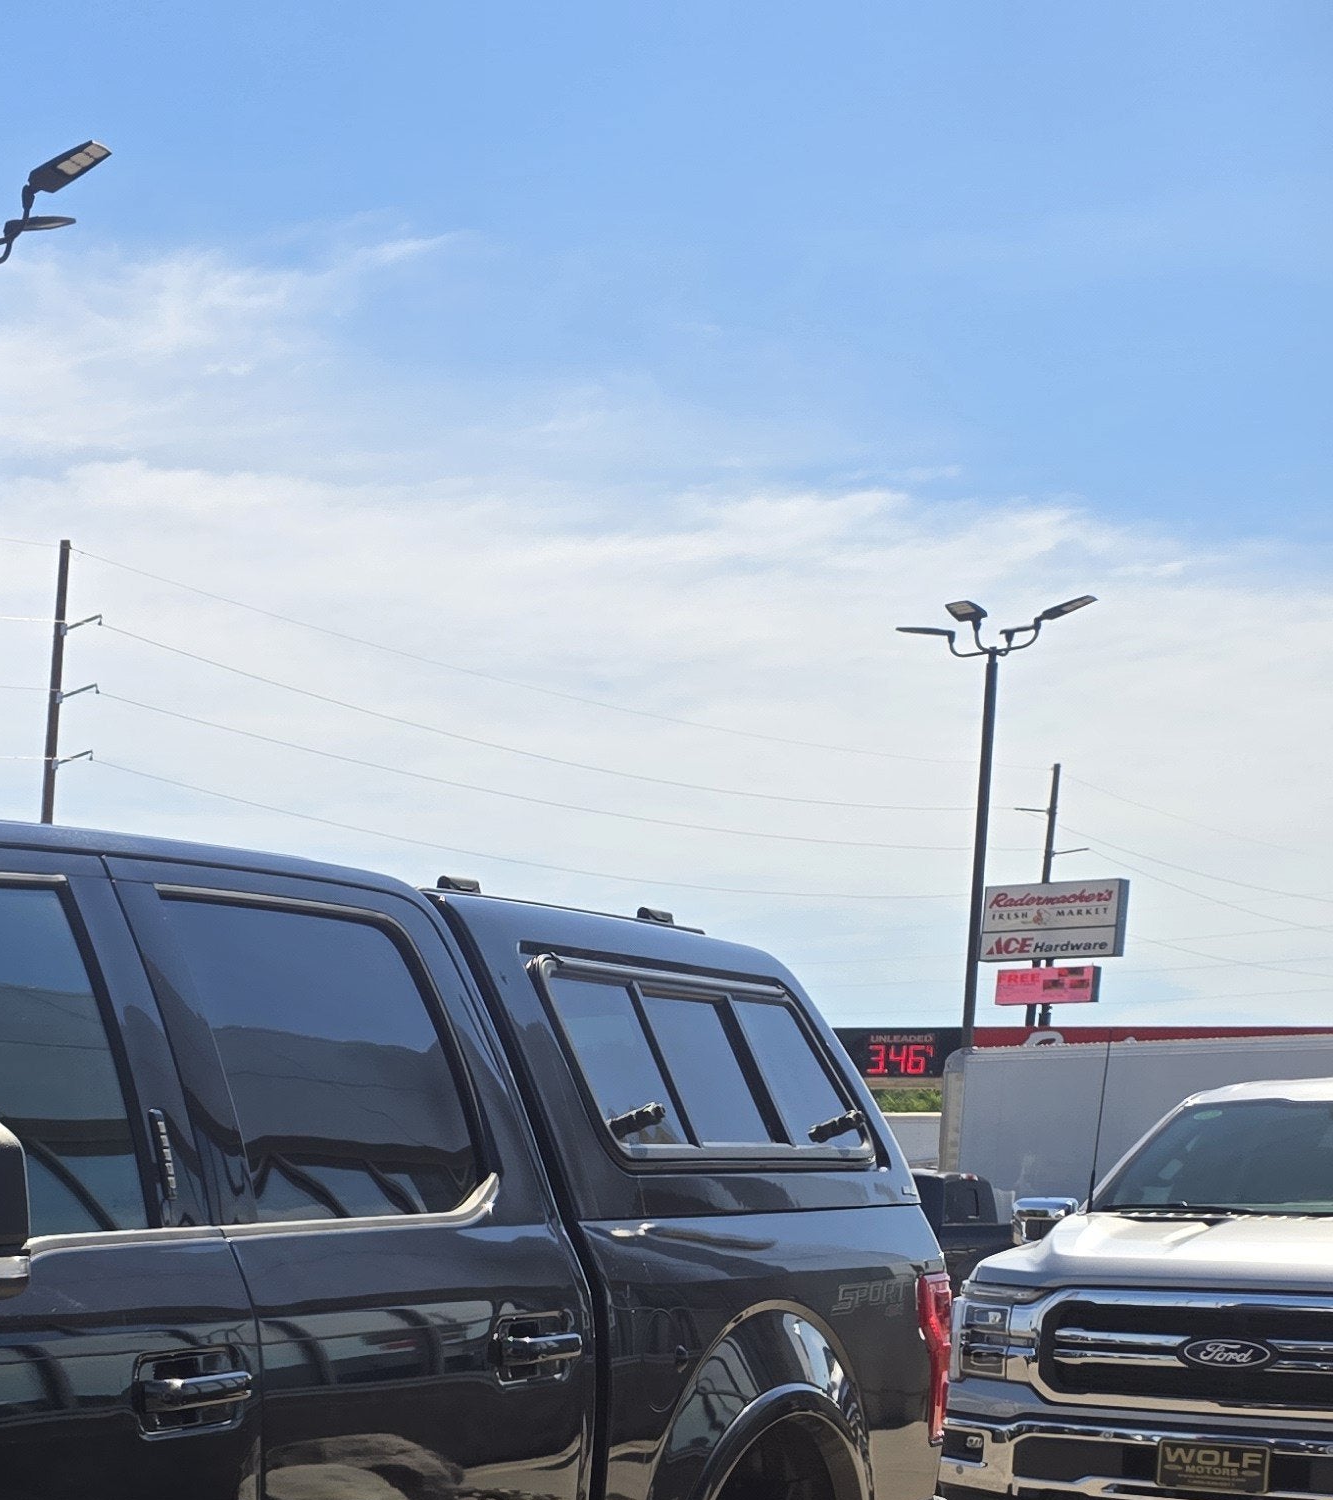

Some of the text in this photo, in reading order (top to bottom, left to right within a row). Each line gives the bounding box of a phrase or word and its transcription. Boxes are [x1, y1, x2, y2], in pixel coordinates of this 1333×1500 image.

[989, 889, 1114, 910] Radermacher's
[1055, 907, 1110, 917] MARKET
[986, 936, 1109, 956] ACE Hardware
[998, 973, 1040, 983] FREE
[869, 1034, 934, 1043] UNLEADED
[831, 1280, 913, 1316] SPORT
[1199, 1342, 1254, 1363] Ford
[1165, 1446, 1263, 1469] WOLF
[1185, 1465, 1239, 1477] MOTORS
